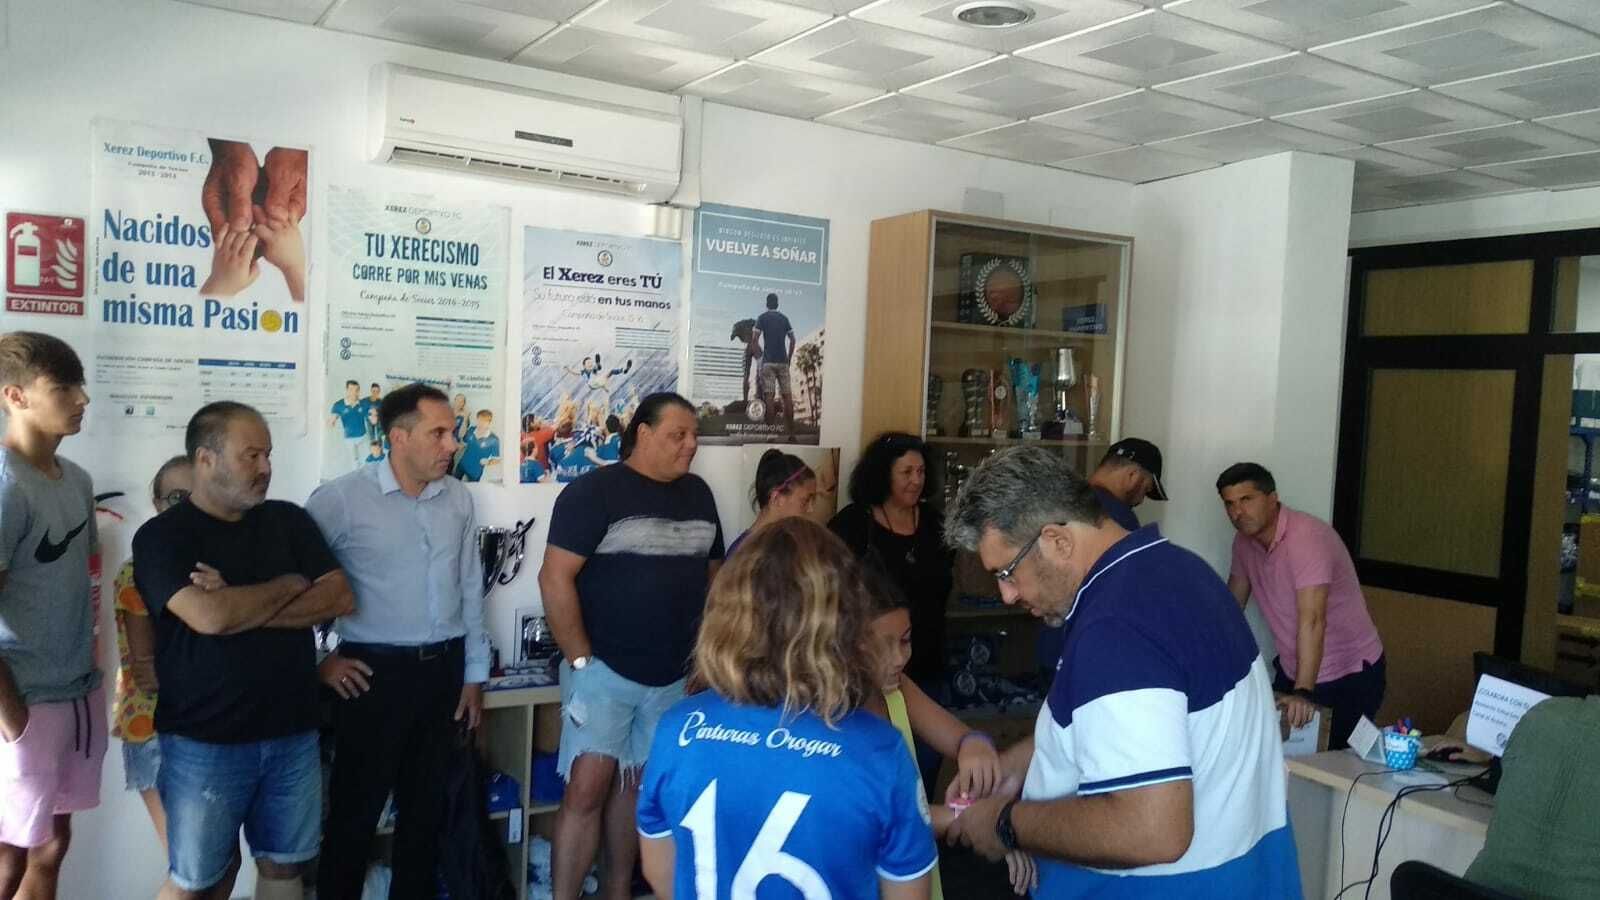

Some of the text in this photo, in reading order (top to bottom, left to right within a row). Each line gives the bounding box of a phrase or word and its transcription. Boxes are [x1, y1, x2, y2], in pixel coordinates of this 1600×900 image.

[104, 142, 134, 155] Xerez
[137, 146, 187, 161] Deportivo
[104, 209, 211, 248] Nacidos
[364, 232, 480, 267] TU XERECISMO
[706, 238, 816, 264] VUELVE A SOÑAR
[103, 251, 135, 284] de
[146, 261, 197, 288] una
[352, 263, 488, 290] CORRE POR MIS VENAS
[543, 266, 663, 290] El Xerez eres TÚ
[10, 299, 78, 313] EXTINTOR
[103, 293, 194, 327] misma
[598, 296, 612, 305] en
[615, 296, 632, 307] tus
[634, 299, 671, 310] manos
[678, 710, 842, 758] Pinturas Orogar
[679, 778, 833, 900] 16
